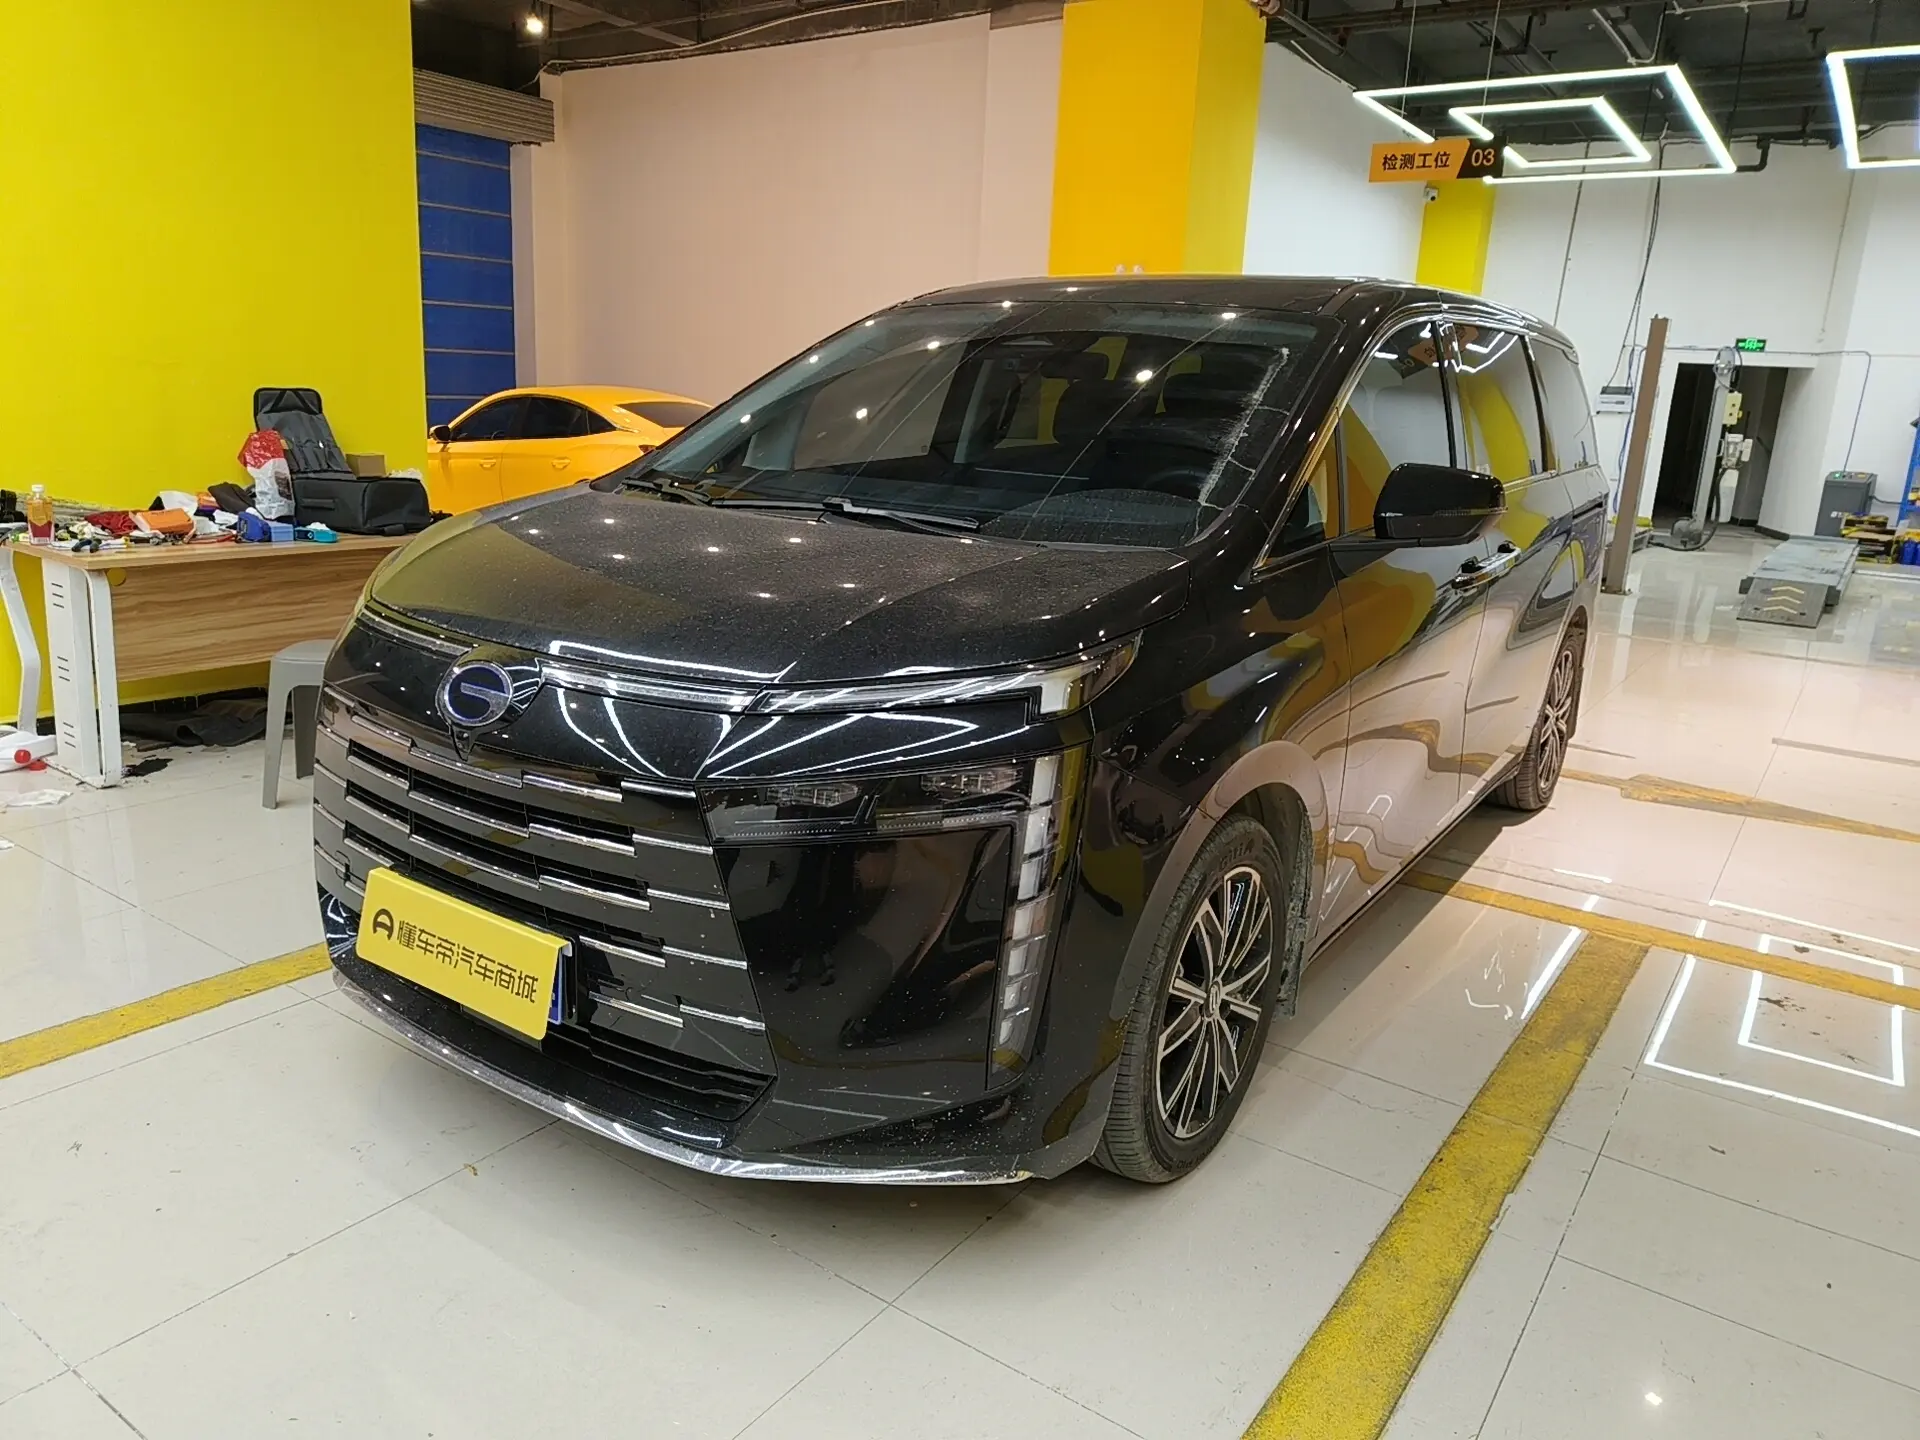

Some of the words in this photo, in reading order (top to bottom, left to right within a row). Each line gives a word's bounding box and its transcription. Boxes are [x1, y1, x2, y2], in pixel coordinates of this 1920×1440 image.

[1382, 151, 1451, 171] 检测工位
[1471, 148, 1495, 166] 03
[396, 919, 539, 1003] 懂车帝汽车商城
